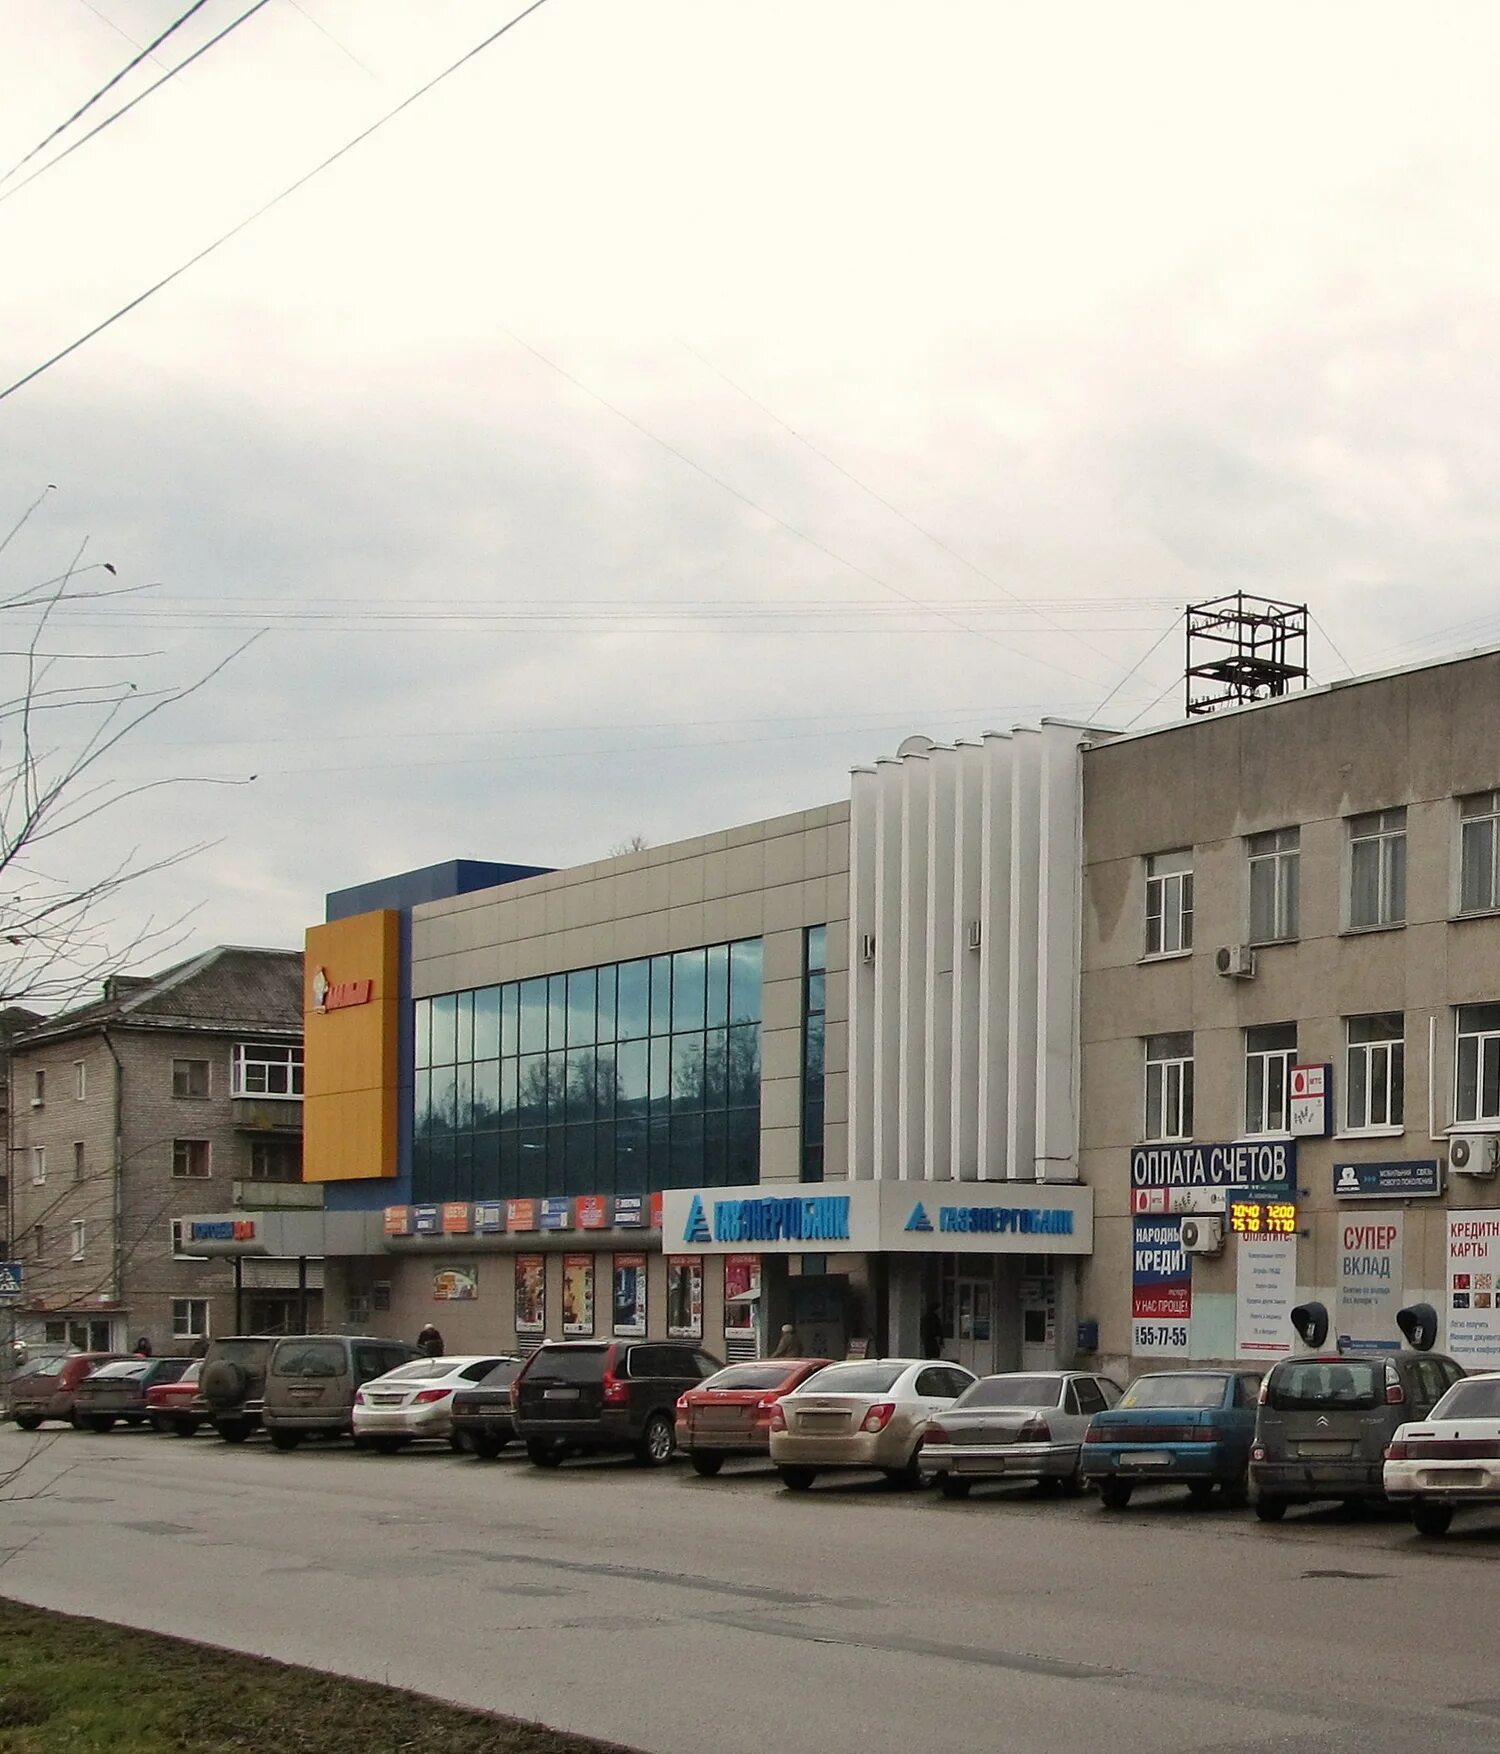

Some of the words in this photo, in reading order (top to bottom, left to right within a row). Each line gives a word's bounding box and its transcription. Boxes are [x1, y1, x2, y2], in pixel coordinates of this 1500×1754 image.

[1133, 1149, 1206, 1185] ОПЛАТА
[1210, 1145, 1287, 1183] СЧЕТОВ
[940, 1206, 1073, 1234] ГАЗЭНЕРГОБАНК
[1343, 1226, 1397, 1250] СУПЕР
[1450, 1242, 1488, 1257] КАРТЫ
[1343, 1256, 1390, 1278] ВКЛАД
[1142, 1301, 1156, 1312] НАС
[1158, 1300, 1188, 1314] ПРОЩЕ!
[1141, 1326, 1187, 1346] 55-77-55
